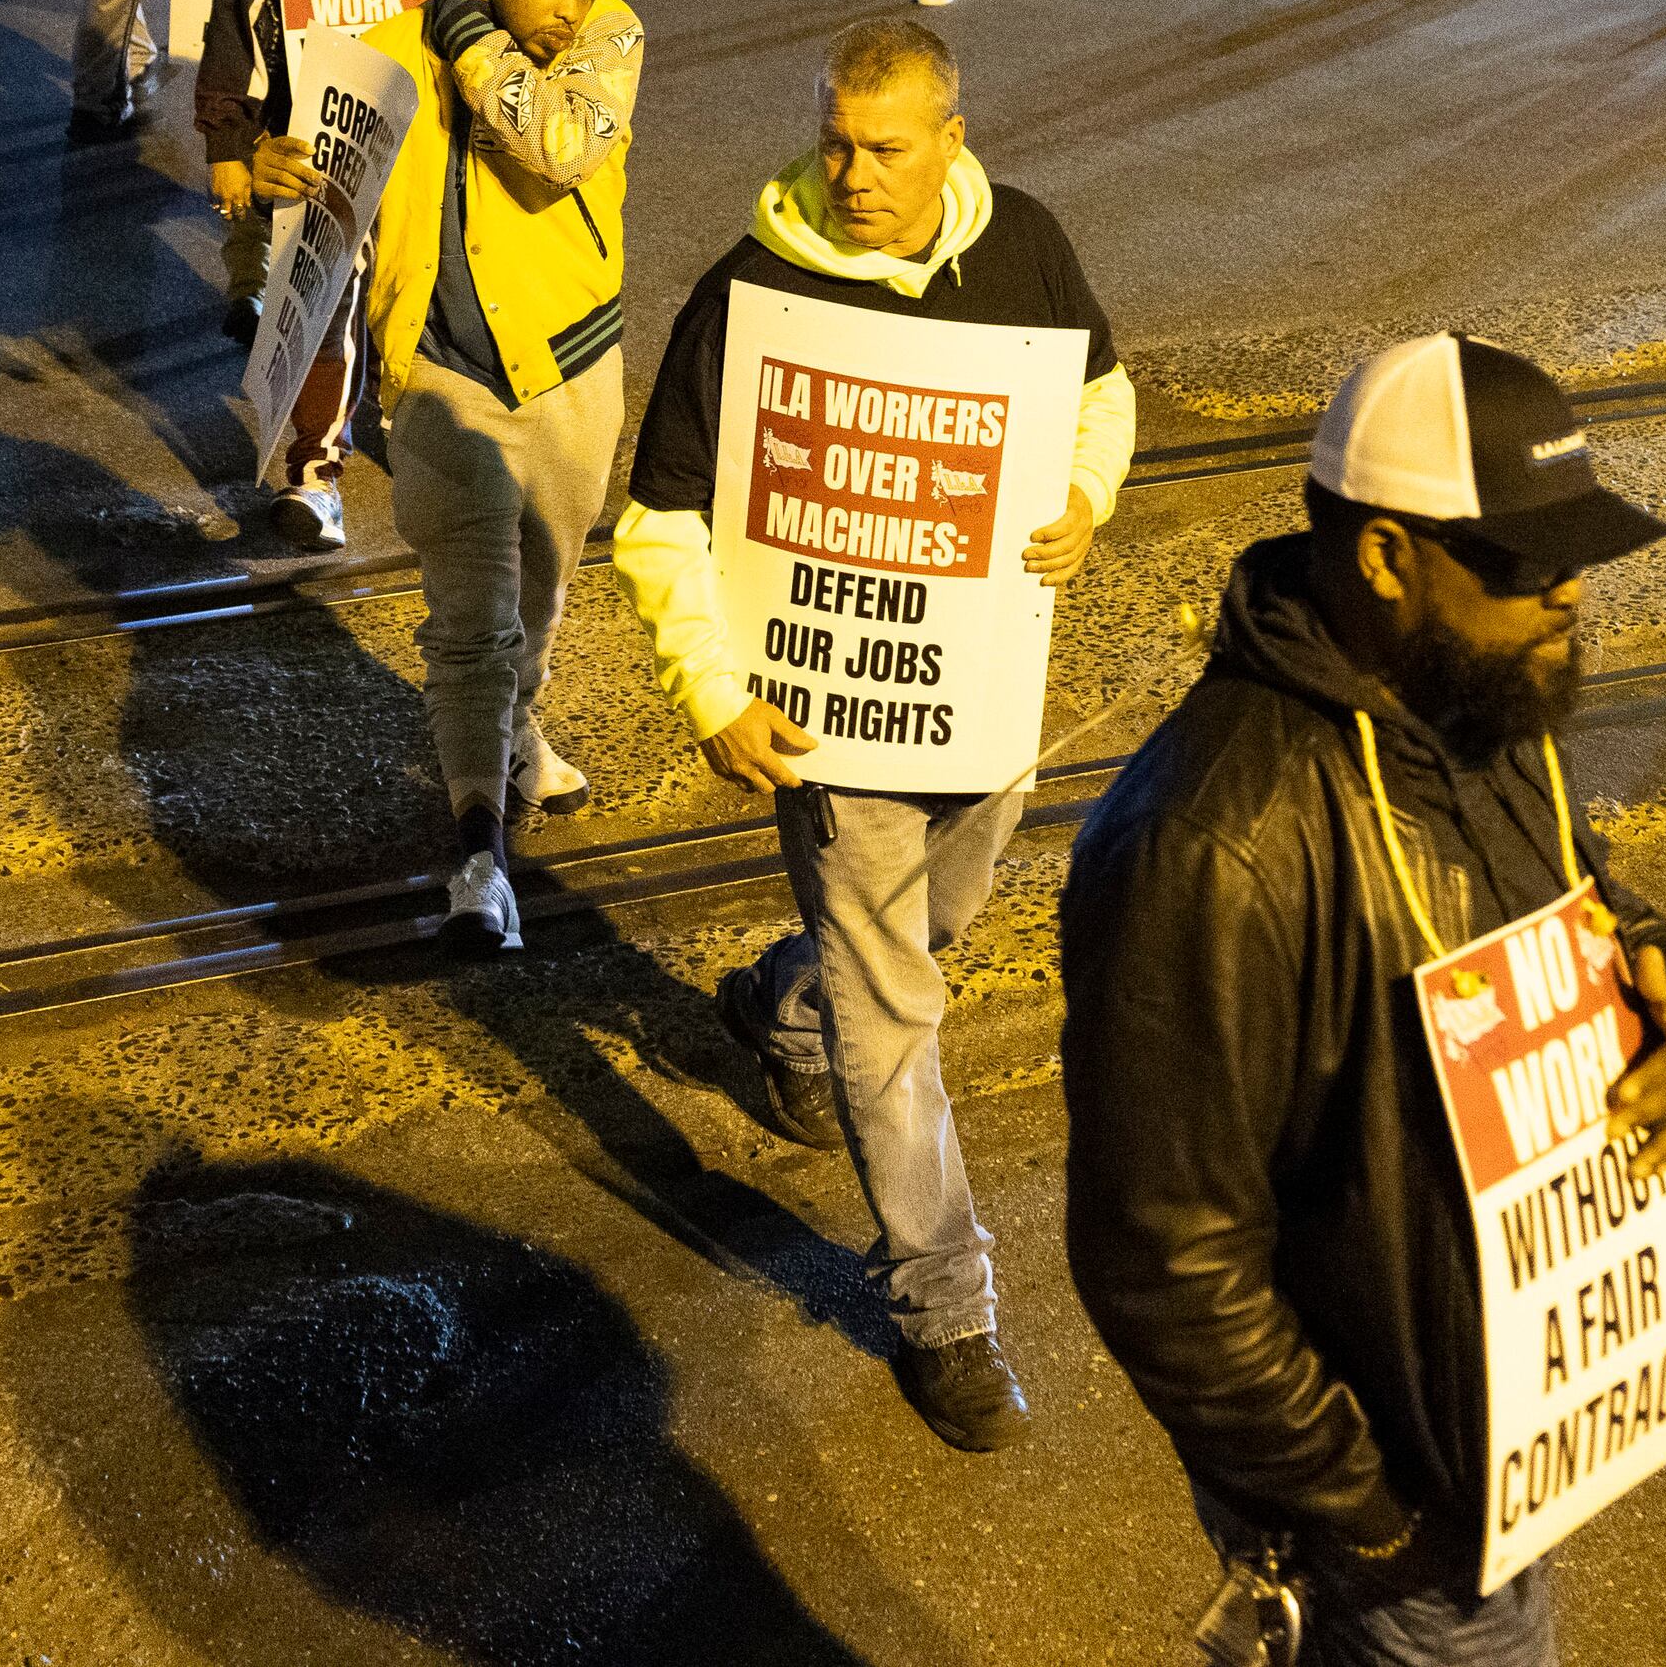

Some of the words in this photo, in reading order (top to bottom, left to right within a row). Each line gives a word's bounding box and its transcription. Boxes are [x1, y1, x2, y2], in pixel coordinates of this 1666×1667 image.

[312, 131, 367, 200] GREED
[760, 363, 811, 421] ILA
[825, 378, 1005, 448] WORKERS
[823, 443, 920, 503] OVER
[765, 491, 970, 568] MACHINES:
[790, 561, 927, 625] DEFEND
[765, 617, 833, 674] OUR
[845, 637, 943, 686] JOBS
[823, 692, 954, 746] RIGHTS
[1503, 915, 1581, 1032] NO
[1490, 1004, 1627, 1165] WORK
[1545, 1306, 1568, 1394] A
[1579, 1246, 1661, 1370] FAIR
